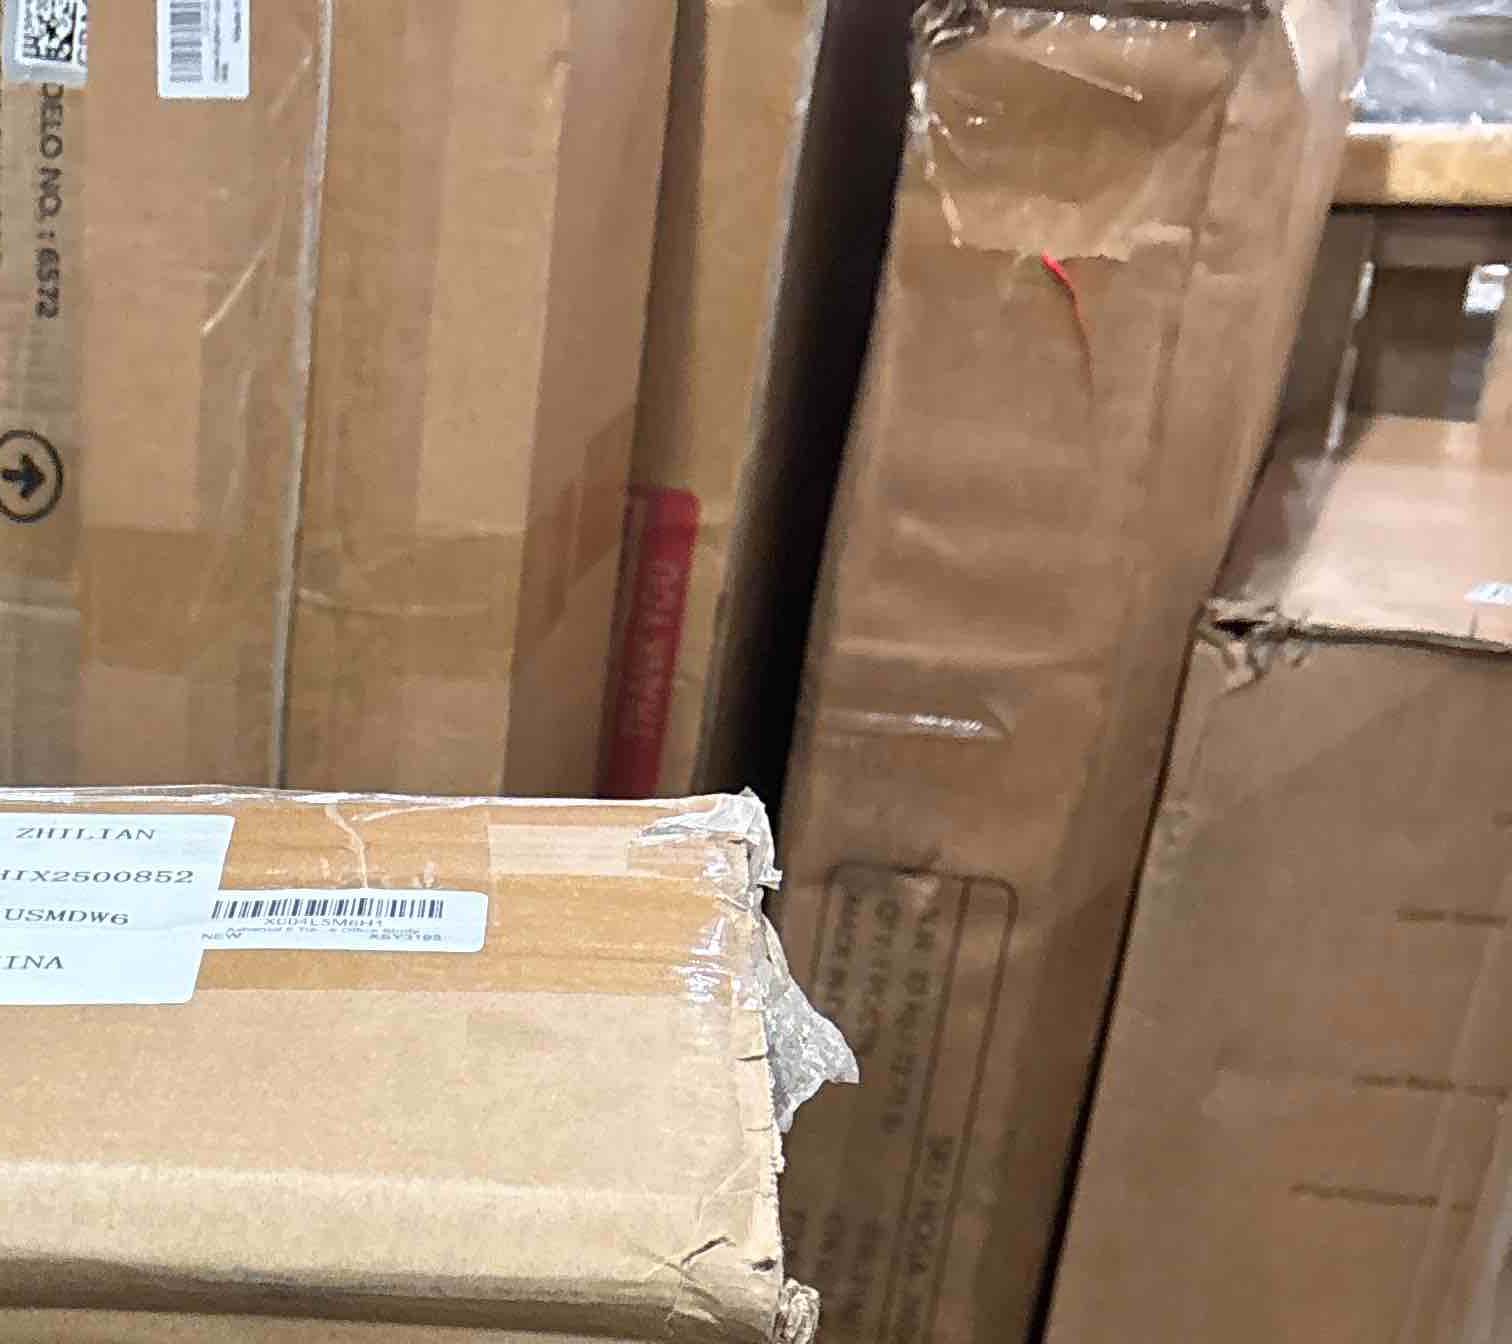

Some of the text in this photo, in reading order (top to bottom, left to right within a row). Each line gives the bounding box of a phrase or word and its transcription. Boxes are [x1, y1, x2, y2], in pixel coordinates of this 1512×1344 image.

[35, 247, 61, 319] 6572
[15, 827, 156, 841] ZHILIAN
[4, 907, 130, 926] USMDW6
